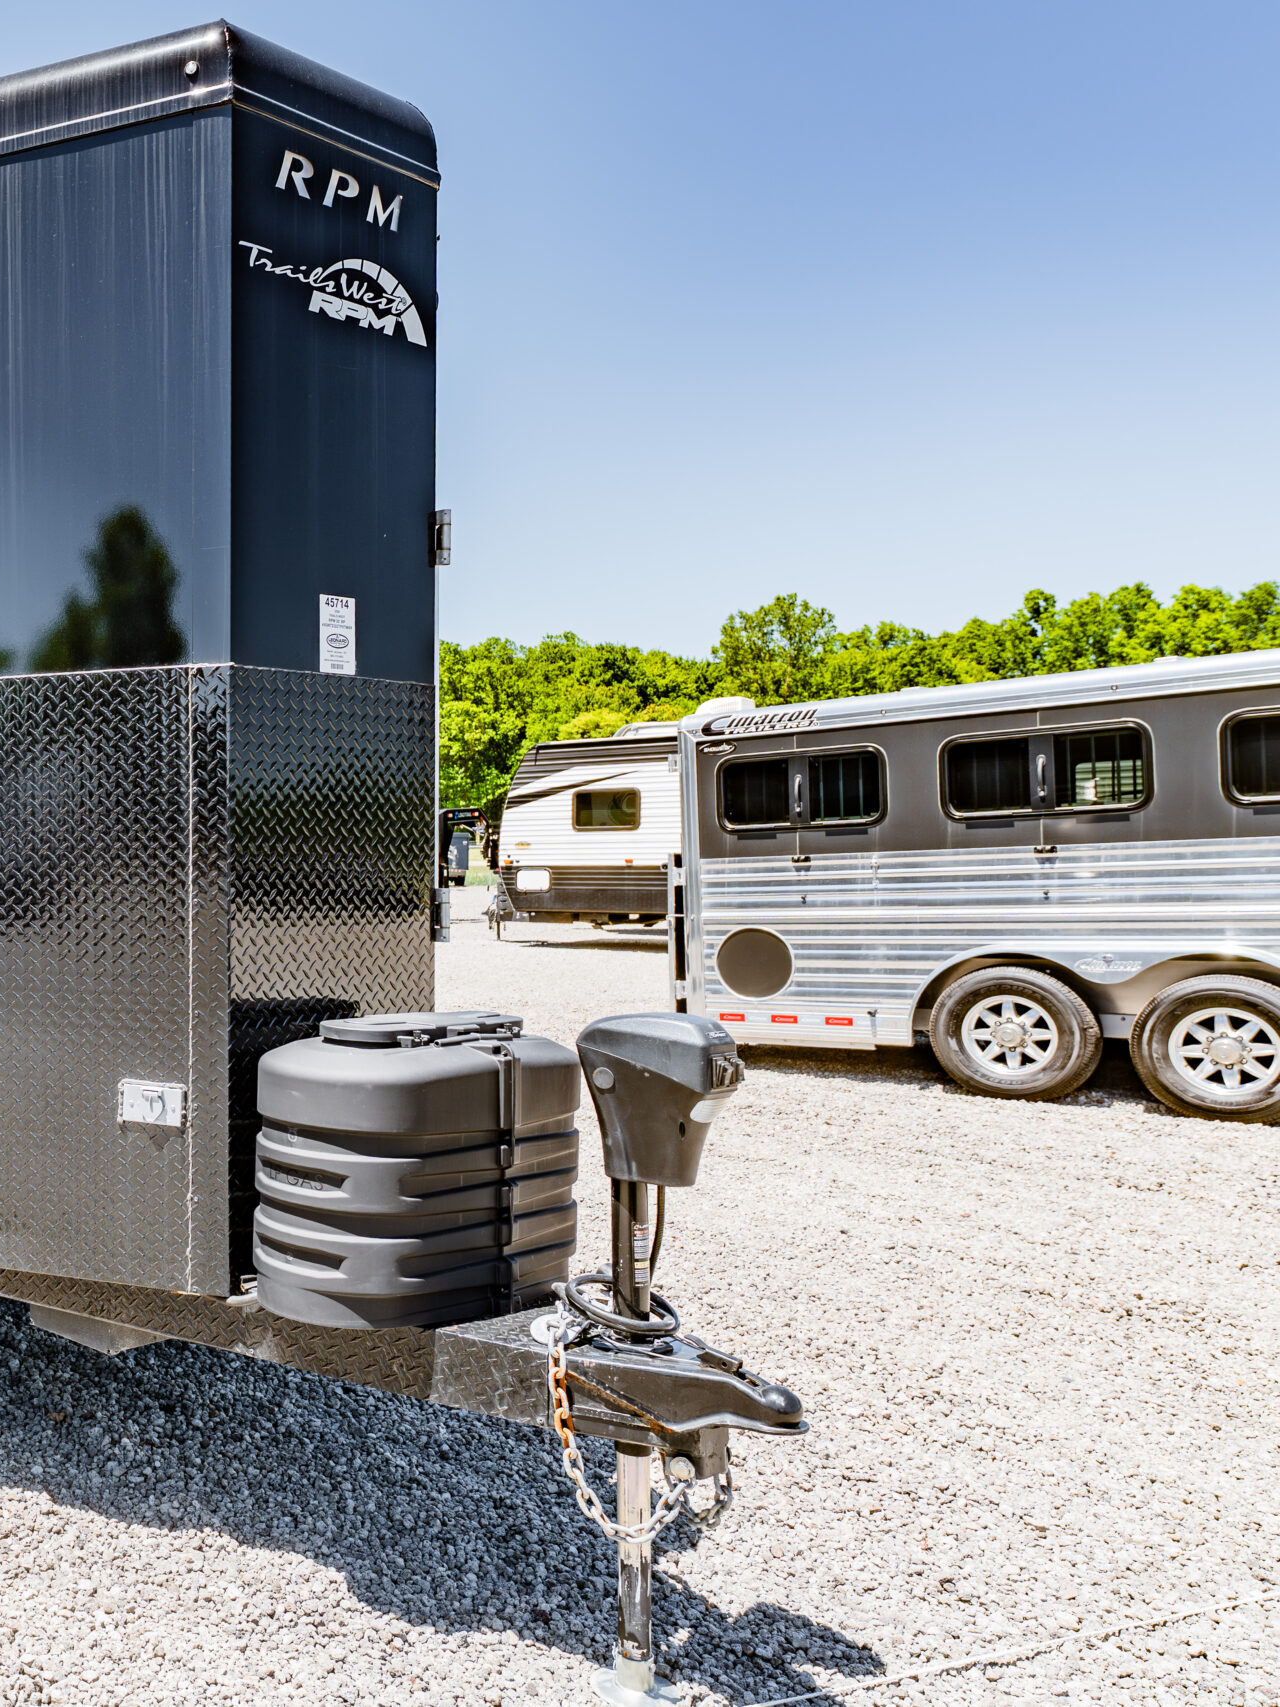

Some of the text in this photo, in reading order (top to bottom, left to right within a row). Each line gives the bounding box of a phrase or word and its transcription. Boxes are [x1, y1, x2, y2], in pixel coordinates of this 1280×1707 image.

[275, 149, 403, 233] RPM
[238, 240, 407, 314] Trails West
[308, 289, 397, 337] RPM
[324, 597, 349, 609] 45714
[701, 708, 818, 737] Cimarron
[723, 719, 815, 735] TRAILERS
